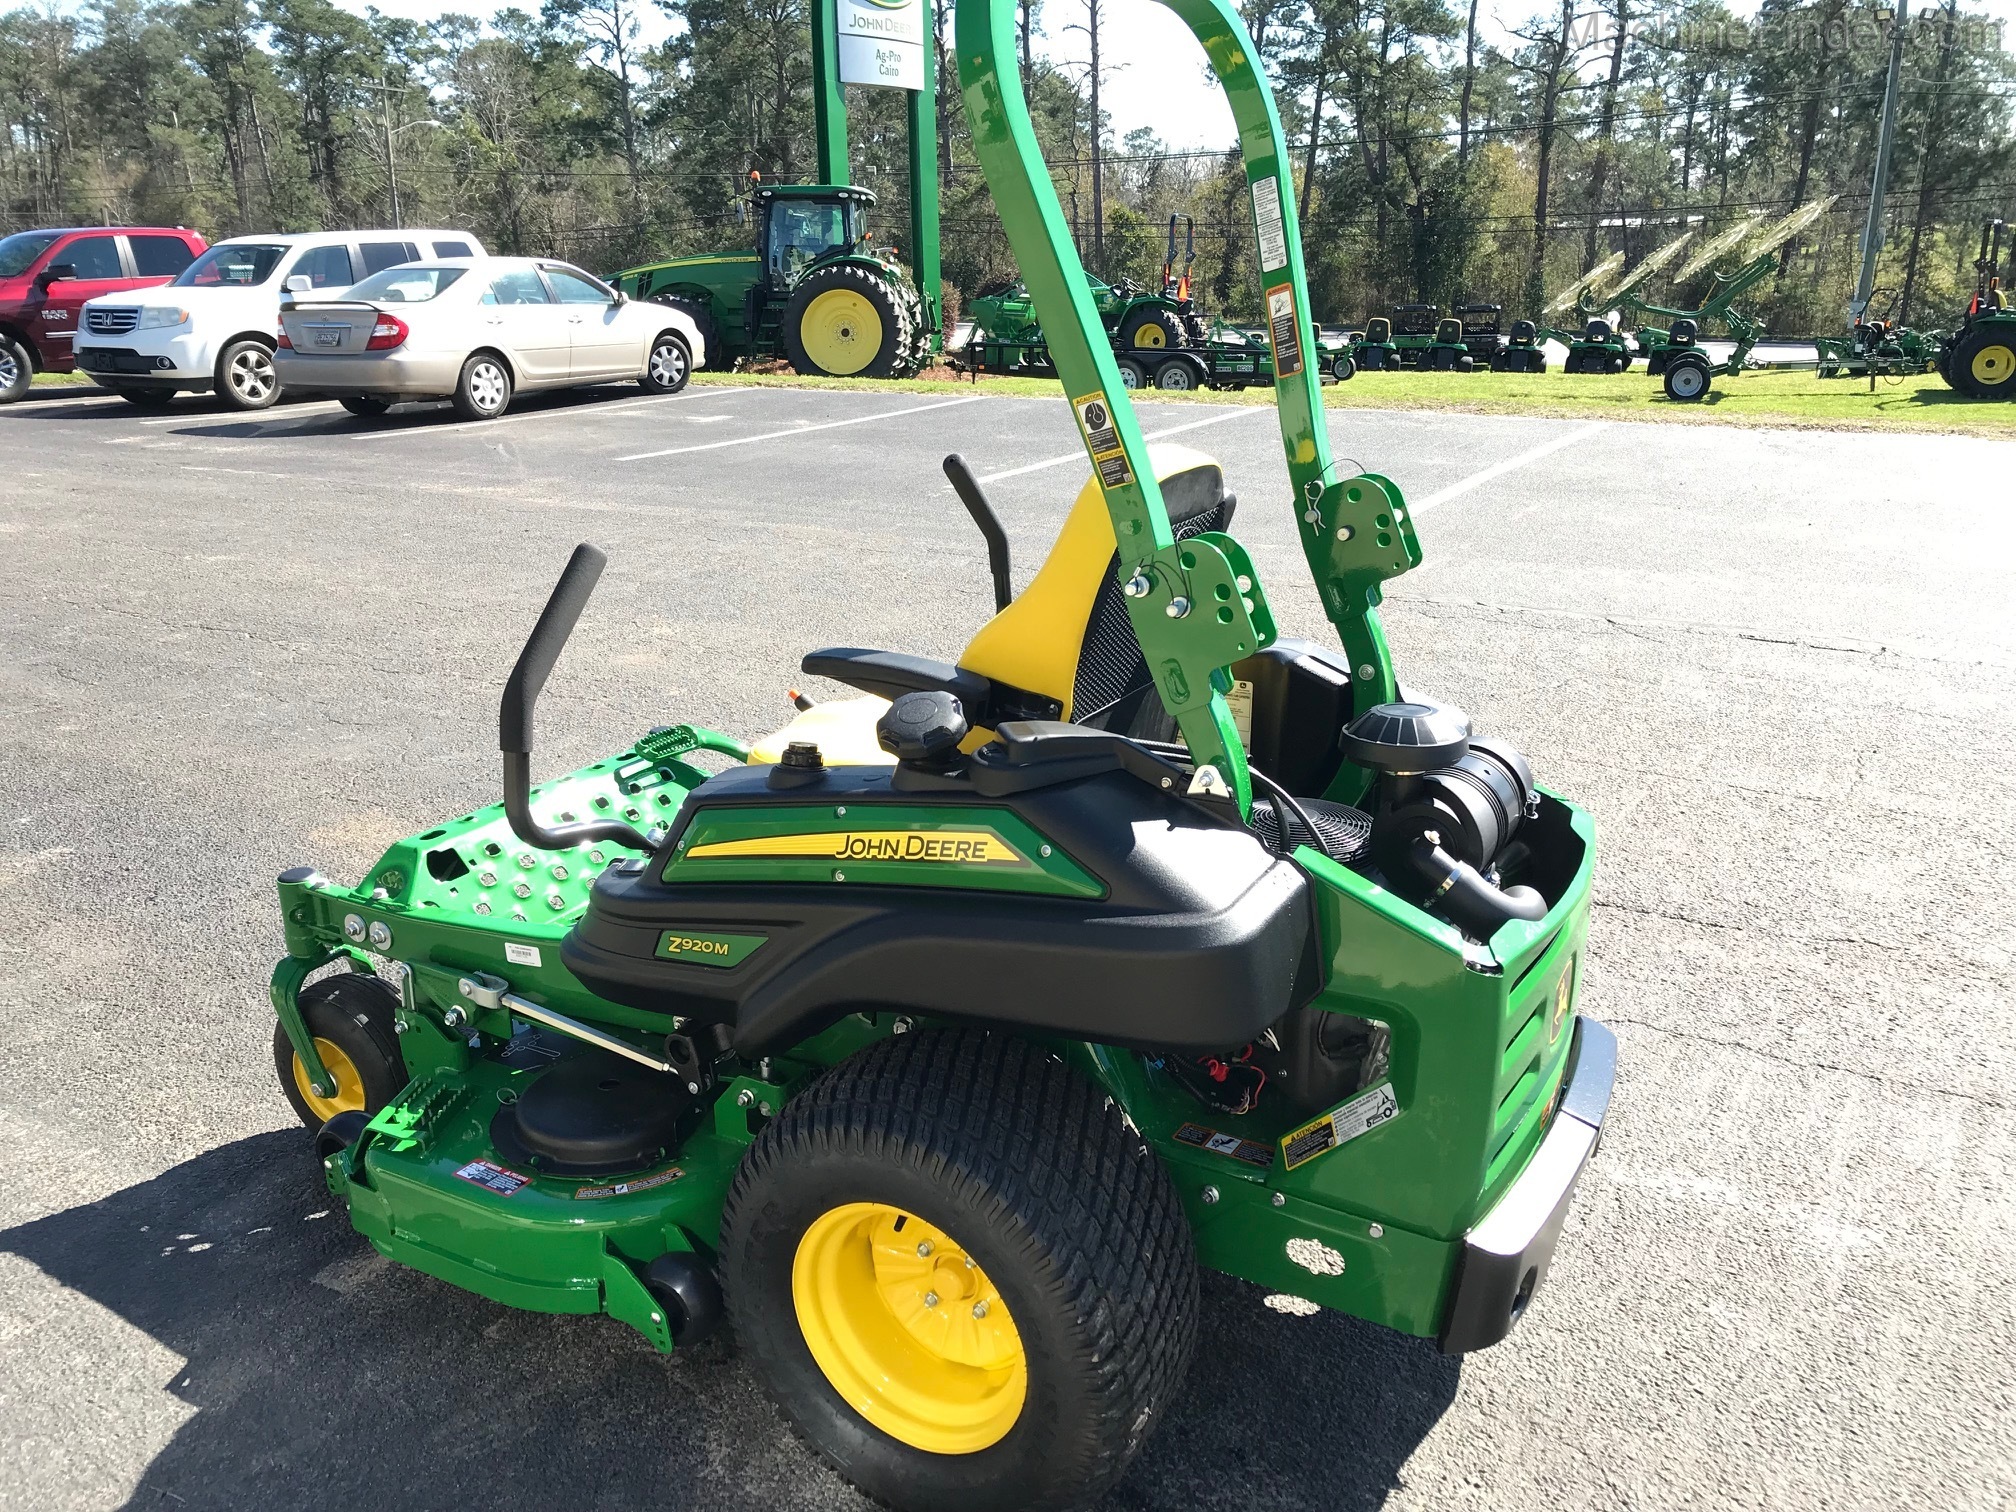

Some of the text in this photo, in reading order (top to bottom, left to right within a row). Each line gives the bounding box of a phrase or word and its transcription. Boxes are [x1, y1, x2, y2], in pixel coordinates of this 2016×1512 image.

[849, 14, 914, 35] JOHN DEER
[876, 49, 902, 63] Ag-Pro
[879, 64, 899, 76] Cairo
[835, 834, 988, 860] JOHN DEERE
[667, 936, 729, 955] Z920M
